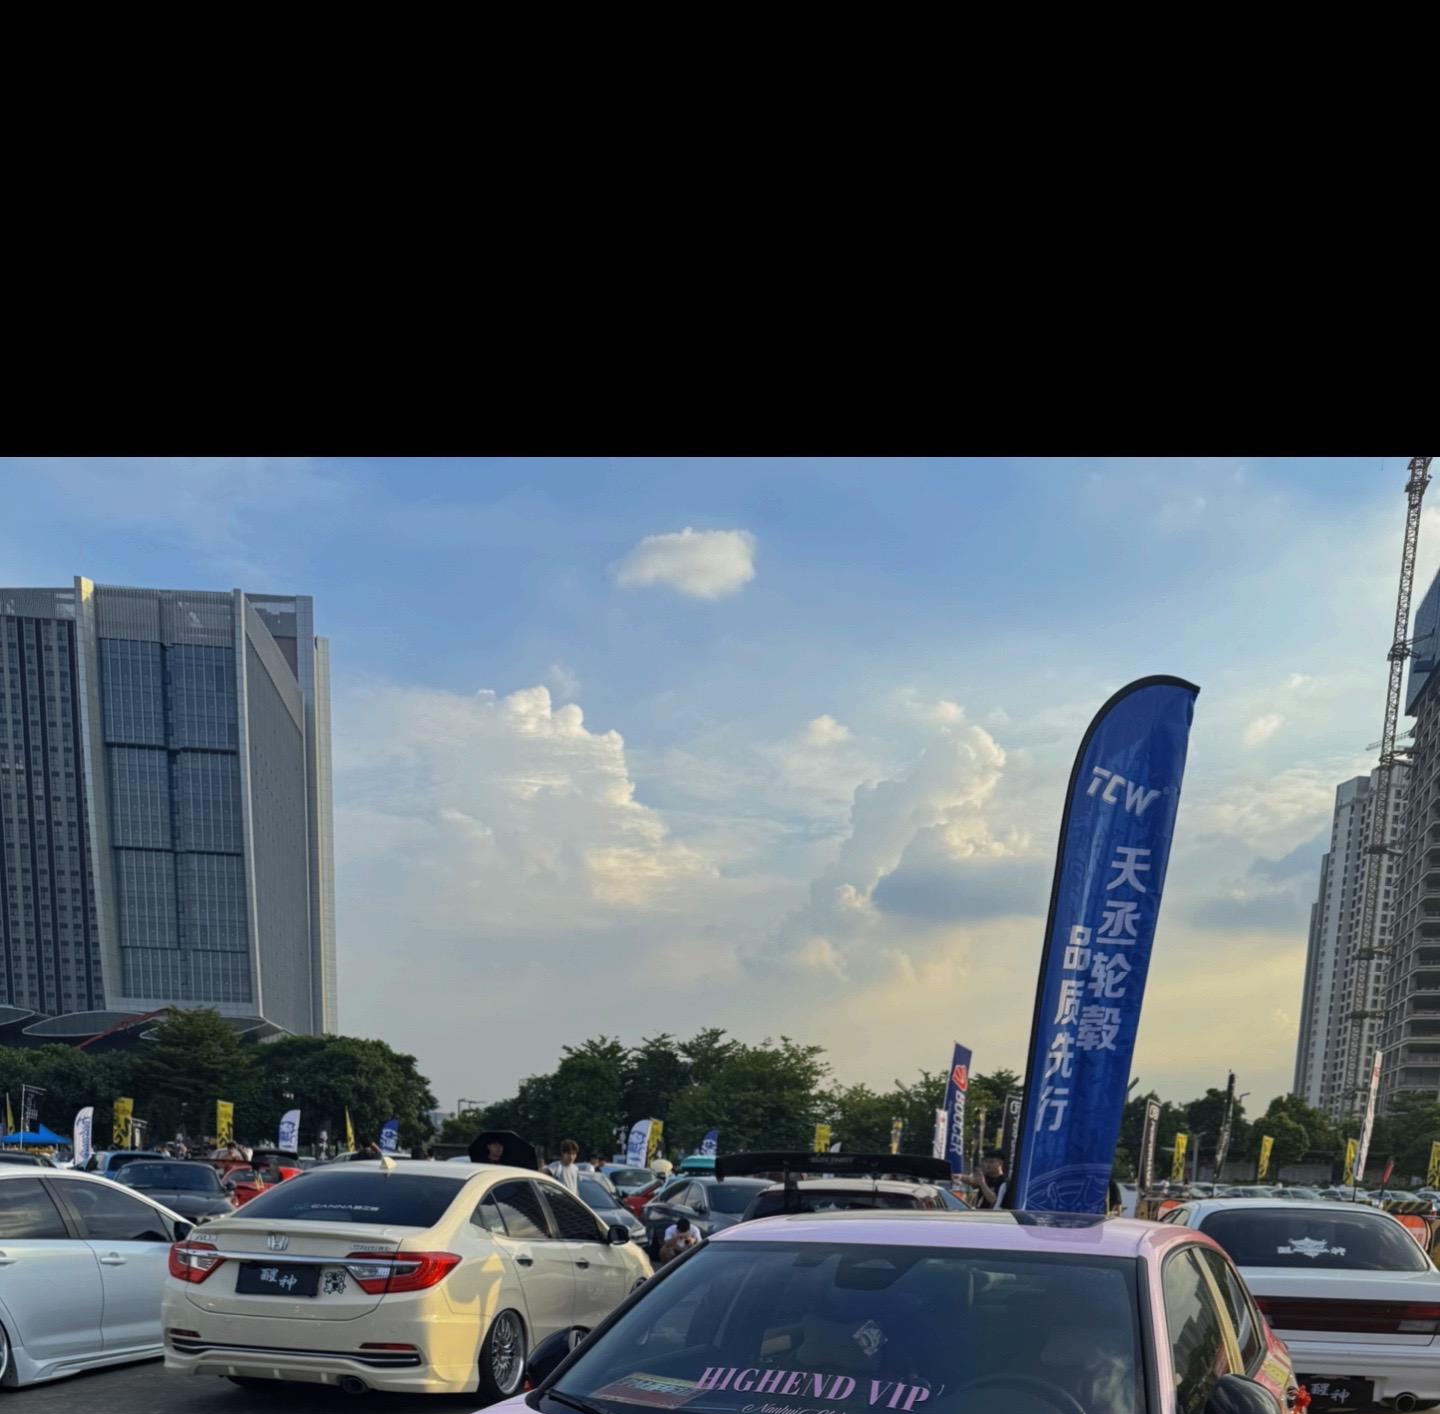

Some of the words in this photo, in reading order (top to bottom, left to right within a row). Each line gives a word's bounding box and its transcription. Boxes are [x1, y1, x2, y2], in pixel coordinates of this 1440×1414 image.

[1086, 765, 1161, 816] TCW
[1076, 846, 1151, 1051] 天丞轮毂
[1035, 925, 1093, 1132] 品质先行
[696, 1366, 857, 1401] HIGHEND
[868, 1379, 931, 1412] VIP
